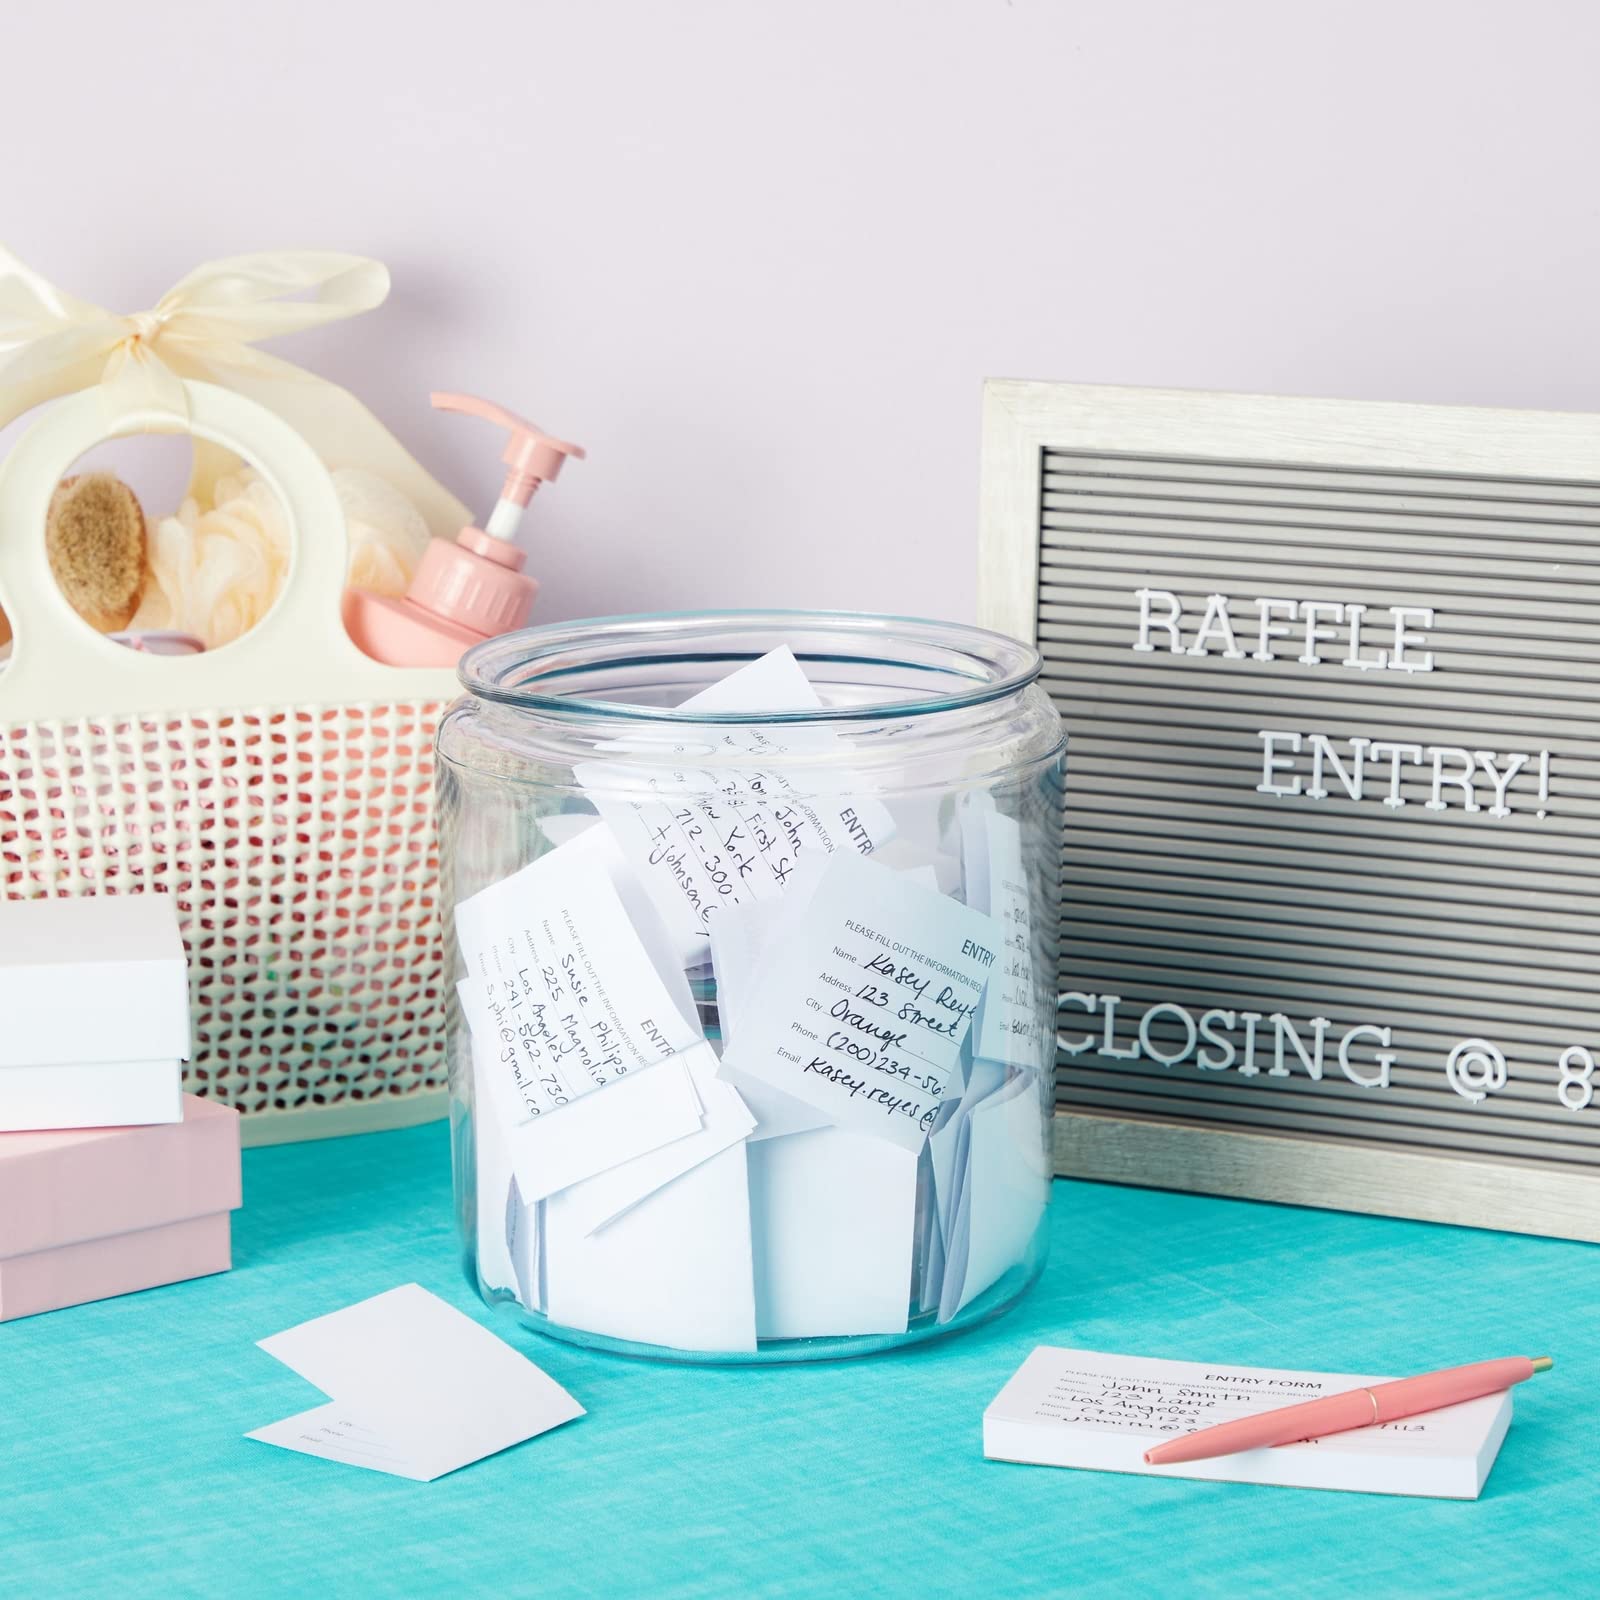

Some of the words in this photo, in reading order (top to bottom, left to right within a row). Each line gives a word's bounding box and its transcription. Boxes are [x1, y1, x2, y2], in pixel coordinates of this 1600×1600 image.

[1132, 587, 1435, 674] RAFFLE
[1256, 729, 1551, 820] ENTRY!
[723, 826, 756, 878] York
[745, 813, 776, 853] First
[832, 945, 858, 964] Name
[844, 919, 876, 940] PLEASE
[875, 934, 891, 948] FILL
[892, 942, 910, 957] OUT
[910, 950, 925, 964] THE
[924, 957, 971, 986] INFORMATION
[961, 938, 997, 969] ENTRY
[561, 953, 589, 1008] Susie
[561, 908, 579, 942] PLEASE
[576, 942, 587, 961] FILL
[584, 960, 598, 980] OUT
[594, 978, 607, 998] THE
[602, 998, 640, 1058] INFORMATION
[819, 972, 852, 993] Address
[863, 953, 931, 1000] Kasey
[518, 968, 533, 995] Los
[529, 1004, 563, 1063] Angeles
[541, 966, 565, 1002] 225
[559, 1014, 608, 1086] Magnolia
[805, 997, 824, 1012] City
[830, 998, 907, 1052] Orange
[855, 984, 889, 1007] 123
[897, 1002, 958, 1038] Street
[791, 1022, 819, 1041] Phone
[1056, 991, 1397, 1089] CLOSING
[1446, 1038, 1507, 1104] @
[1558, 1045, 1594, 1111] 8
[776, 1046, 802, 1065] Email
[826, 1031, 947, 1095] (200)234-56
[1070, 1395, 1104, 1406] Los
[1113, 1400, 1201, 1415] Angeles
[1100, 1390, 1143, 1401] 123
[1157, 1396, 1216, 1408] Lane
[1101, 1381, 1162, 1395] John
[1177, 1388, 1251, 1401] Smith
[1162, 1381, 1229, 1391] INFORMATION
[1205, 1374, 1265, 1385] ENTRY
[1268, 1379, 1323, 1390] FORM
